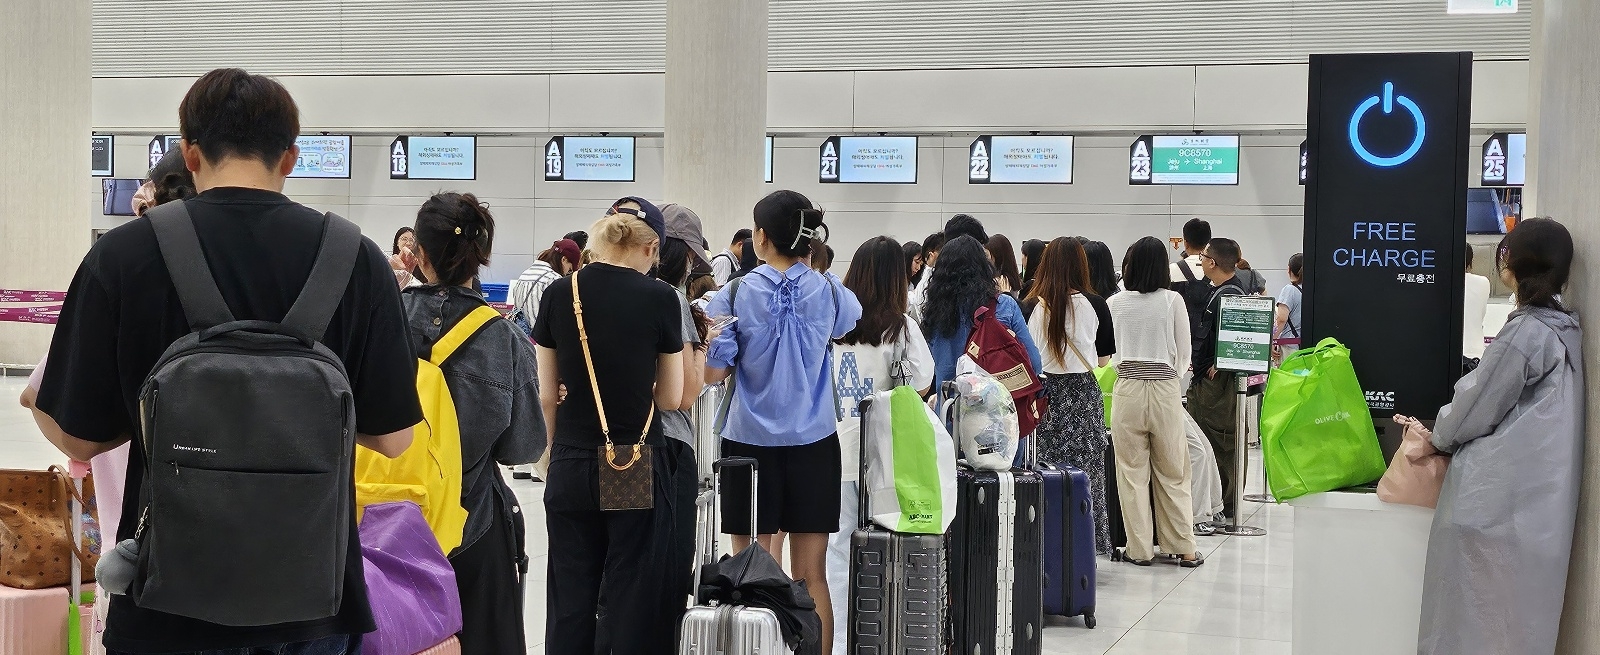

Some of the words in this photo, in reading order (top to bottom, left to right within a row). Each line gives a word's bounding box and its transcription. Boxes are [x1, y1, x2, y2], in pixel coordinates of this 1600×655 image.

[150, 138, 164, 153] A
[394, 141, 406, 154] A
[547, 141, 561, 155] A
[823, 141, 836, 156] A
[974, 141, 987, 156] A
[1134, 141, 1149, 157] A
[1178, 149, 1212, 157] 9C8570
[1486, 138, 1504, 155] A
[392, 158, 406, 172] 18
[546, 159, 562, 174] 19
[820, 160, 838, 175] 21
[970, 160, 989, 175] 22
[1131, 160, 1150, 176] 23
[1193, 158, 1223, 166] Shanghai
[1484, 160, 1505, 177] 25
[1353, 221, 1416, 241] FREE
[1332, 247, 1436, 268] CHARGE
[1397, 273, 1435, 284] 무료충전
[1365, 390, 1395, 402] KAC
[1314, 414, 1335, 425] OLIVE
